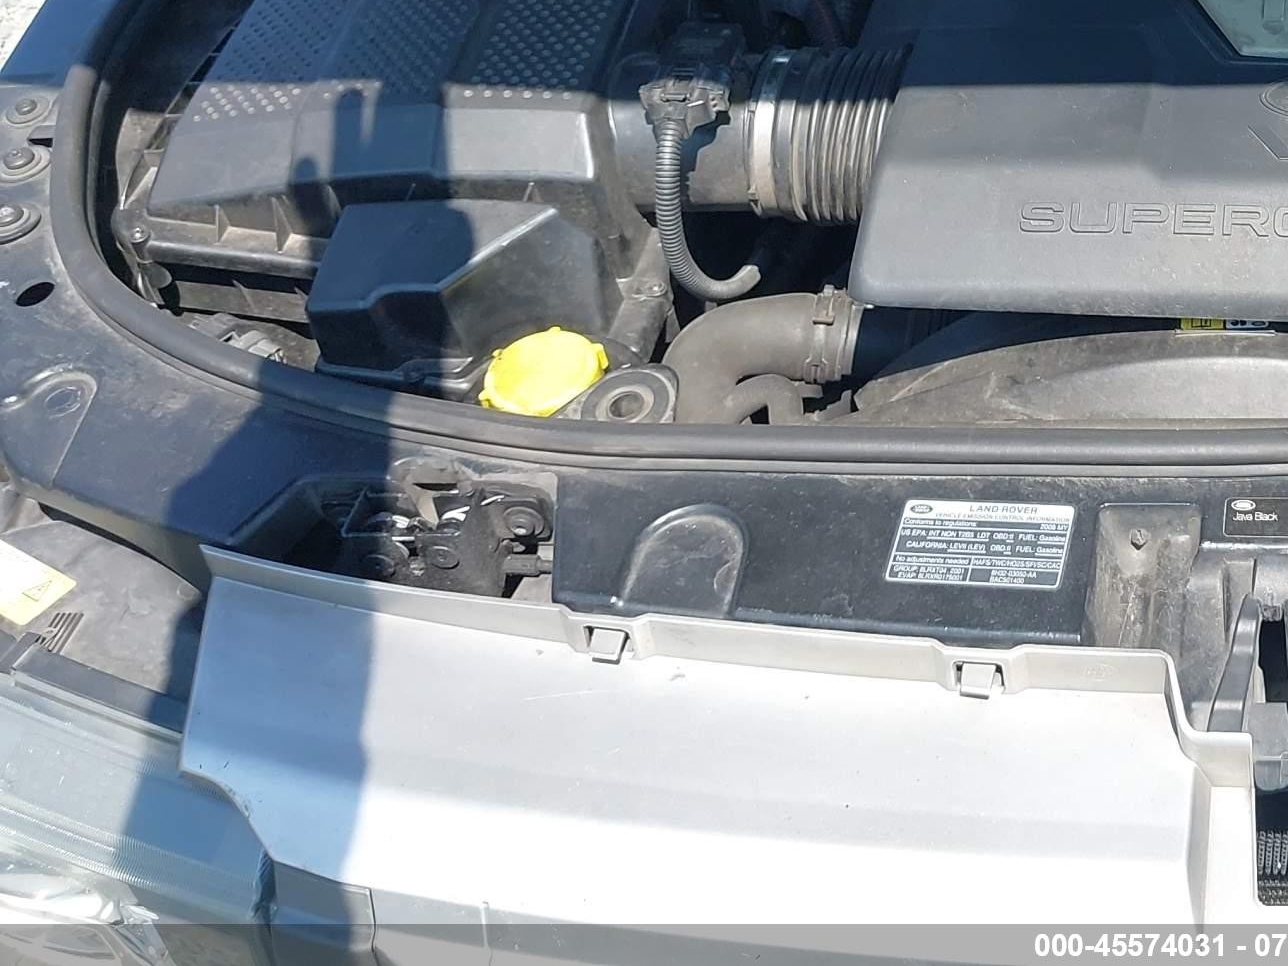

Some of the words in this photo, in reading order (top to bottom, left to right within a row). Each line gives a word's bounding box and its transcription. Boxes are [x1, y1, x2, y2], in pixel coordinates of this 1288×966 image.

[969, 505, 999, 513] LAND
[1001, 506, 1038, 514] ROVER
[1232, 511, 1253, 521] Java
[1254, 511, 1278, 521] Black
